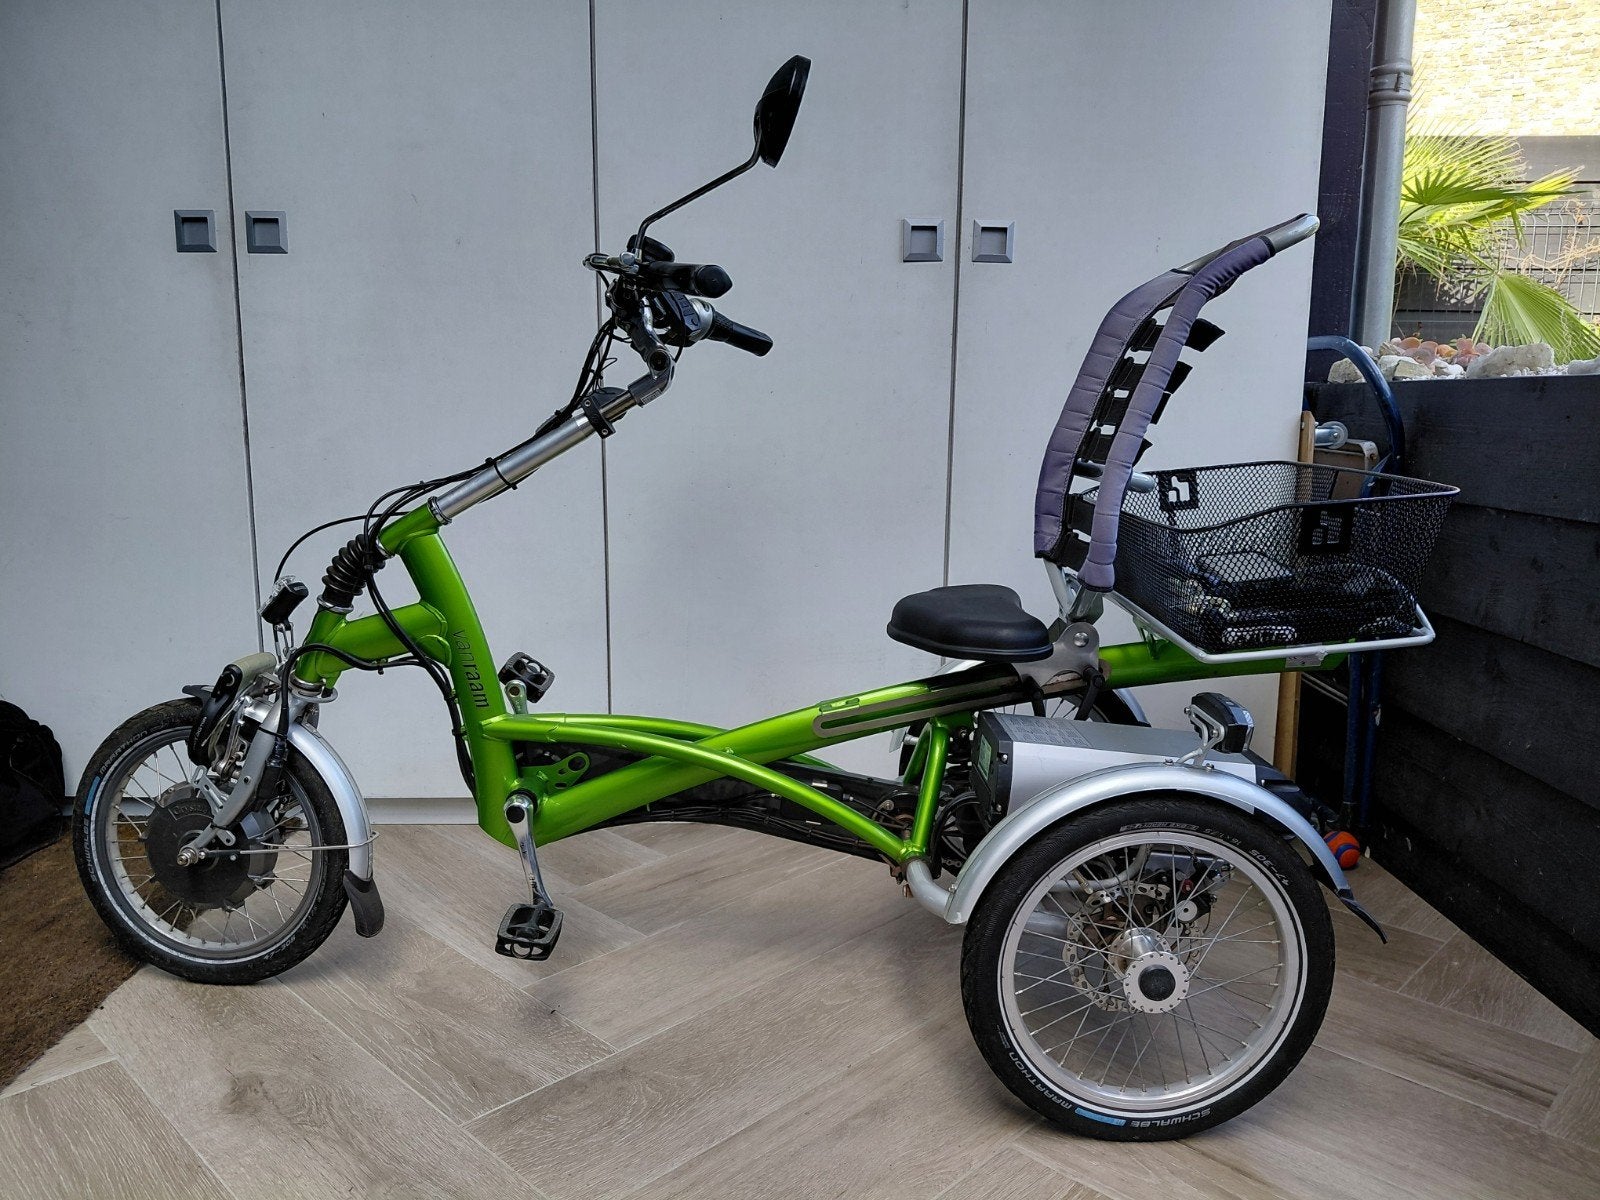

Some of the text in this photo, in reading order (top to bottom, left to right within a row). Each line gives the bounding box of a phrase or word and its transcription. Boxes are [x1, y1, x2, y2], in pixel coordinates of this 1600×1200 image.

[99, 730, 148, 775] MARATHON
[83, 818, 98, 883] SCHWALBE
[1250, 849, 1290, 886] 47-305
[1008, 1051, 1073, 1109] MARATHON
[1130, 1107, 1211, 1128] SCHWALBE
